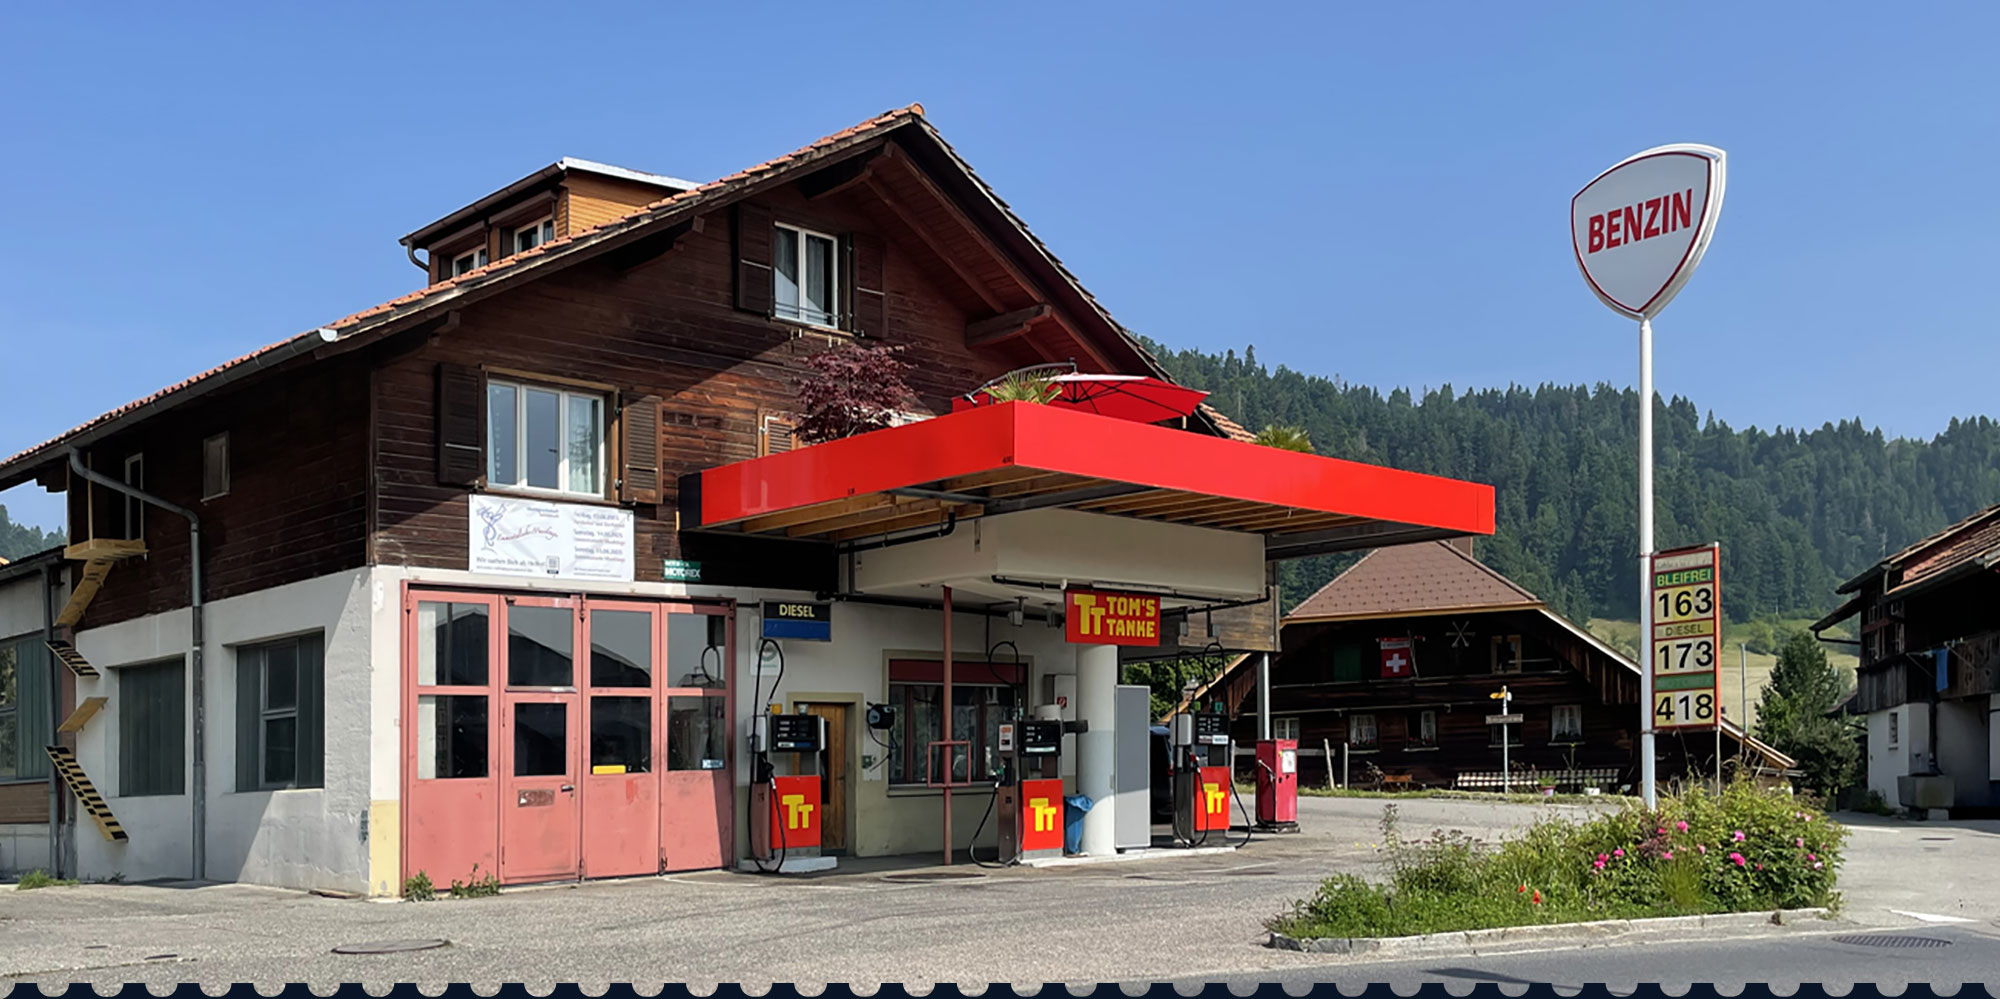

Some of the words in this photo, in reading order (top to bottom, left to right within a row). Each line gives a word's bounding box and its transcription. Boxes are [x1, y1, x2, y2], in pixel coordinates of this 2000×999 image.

[1588, 188, 1693, 254] BENZIN
[1657, 569, 1712, 587] BLEIFREI
[779, 604, 815, 618] DIESEL
[1658, 588, 1712, 618] 163
[1106, 618, 1155, 638] TANKE
[1665, 624, 1704, 636] DIESEL
[1659, 641, 1713, 670] 173
[1656, 694, 1713, 720] 418
